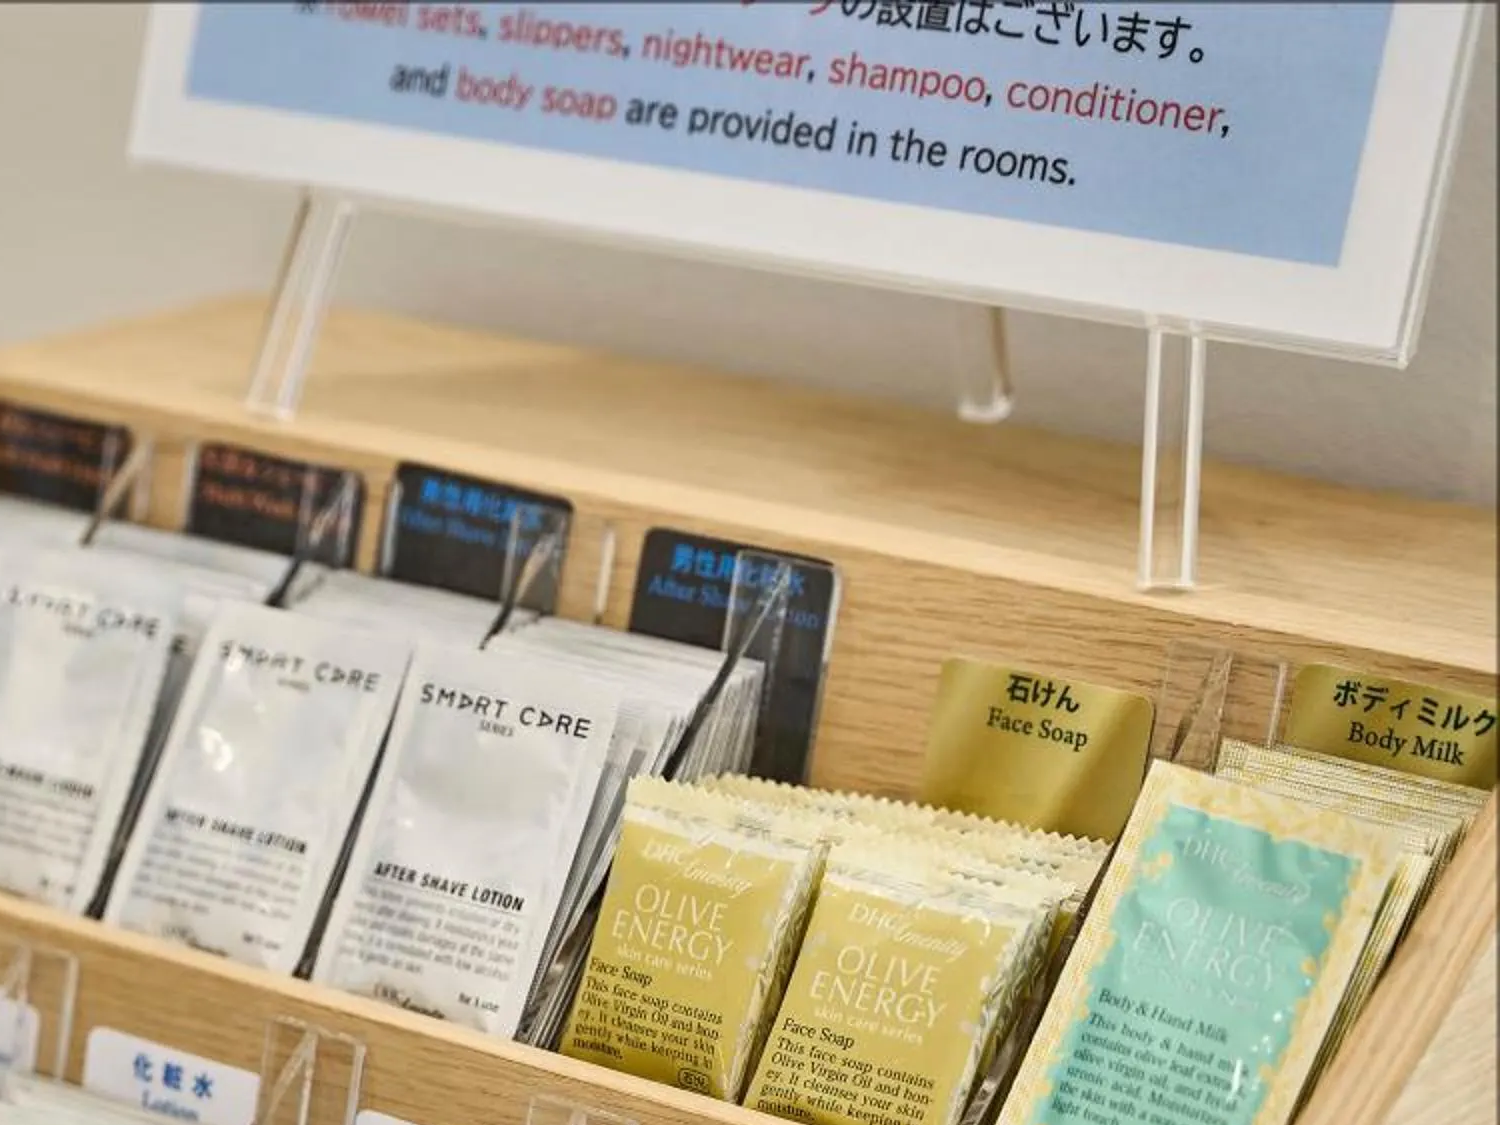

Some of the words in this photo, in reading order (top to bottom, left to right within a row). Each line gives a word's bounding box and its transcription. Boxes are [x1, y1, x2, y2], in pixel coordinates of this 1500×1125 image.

[419, 5, 486, 40] sets,
[498, 14, 629, 60] slippers,
[642, 29, 815, 82] nightwear,
[828, 52, 993, 106] shampoo,
[1006, 80, 1231, 139] conditioner,
[390, 62, 451, 98] and
[455, 66, 530, 110] body
[541, 83, 618, 120] soap
[625, 97, 678, 129] are
[687, 106, 836, 153] provided
[847, 121, 877, 158] in
[890, 130, 947, 167] the
[959, 144, 1076, 186] rooms.
[1006, 673, 1081, 713] 石けん
[1333, 679, 1497, 737] ボディミルク
[518, 705, 593, 739] CARE
[986, 706, 1033, 735] Face
[1038, 719, 1088, 752] Soap
[1349, 720, 1407, 758] Body
[1410, 735, 1465, 766] Milk
[373, 861, 416, 885] AFTER
[420, 872, 469, 898] SHAVE
[471, 886, 526, 913] LOTION
[634, 883, 729, 933] OLIVE
[611, 908, 734, 967] ENERGY
[622, 966, 653, 989] Soap
[836, 944, 942, 995] OLIVE
[809, 970, 948, 1029] ENERGY
[1099, 988, 1133, 1014] Body
[1151, 1005, 1194, 1032] Hand
[781, 1017, 817, 1039] Face
[819, 1027, 855, 1051] Soap
[771, 1051, 805, 1071] Olive
[810, 1061, 849, 1084] Virgin
[852, 1073, 873, 1090] Oil
[875, 1081, 901, 1098] and
[777, 1036, 805, 1055] This
[809, 1045, 837, 1064] face
[841, 1056, 873, 1075] soap
[877, 1065, 936, 1091] contains
[803, 1077, 859, 1102] cleanses
[861, 1094, 894, 1111] your
[896, 1102, 925, 1121] skin
[807, 1094, 843, 1114] while
